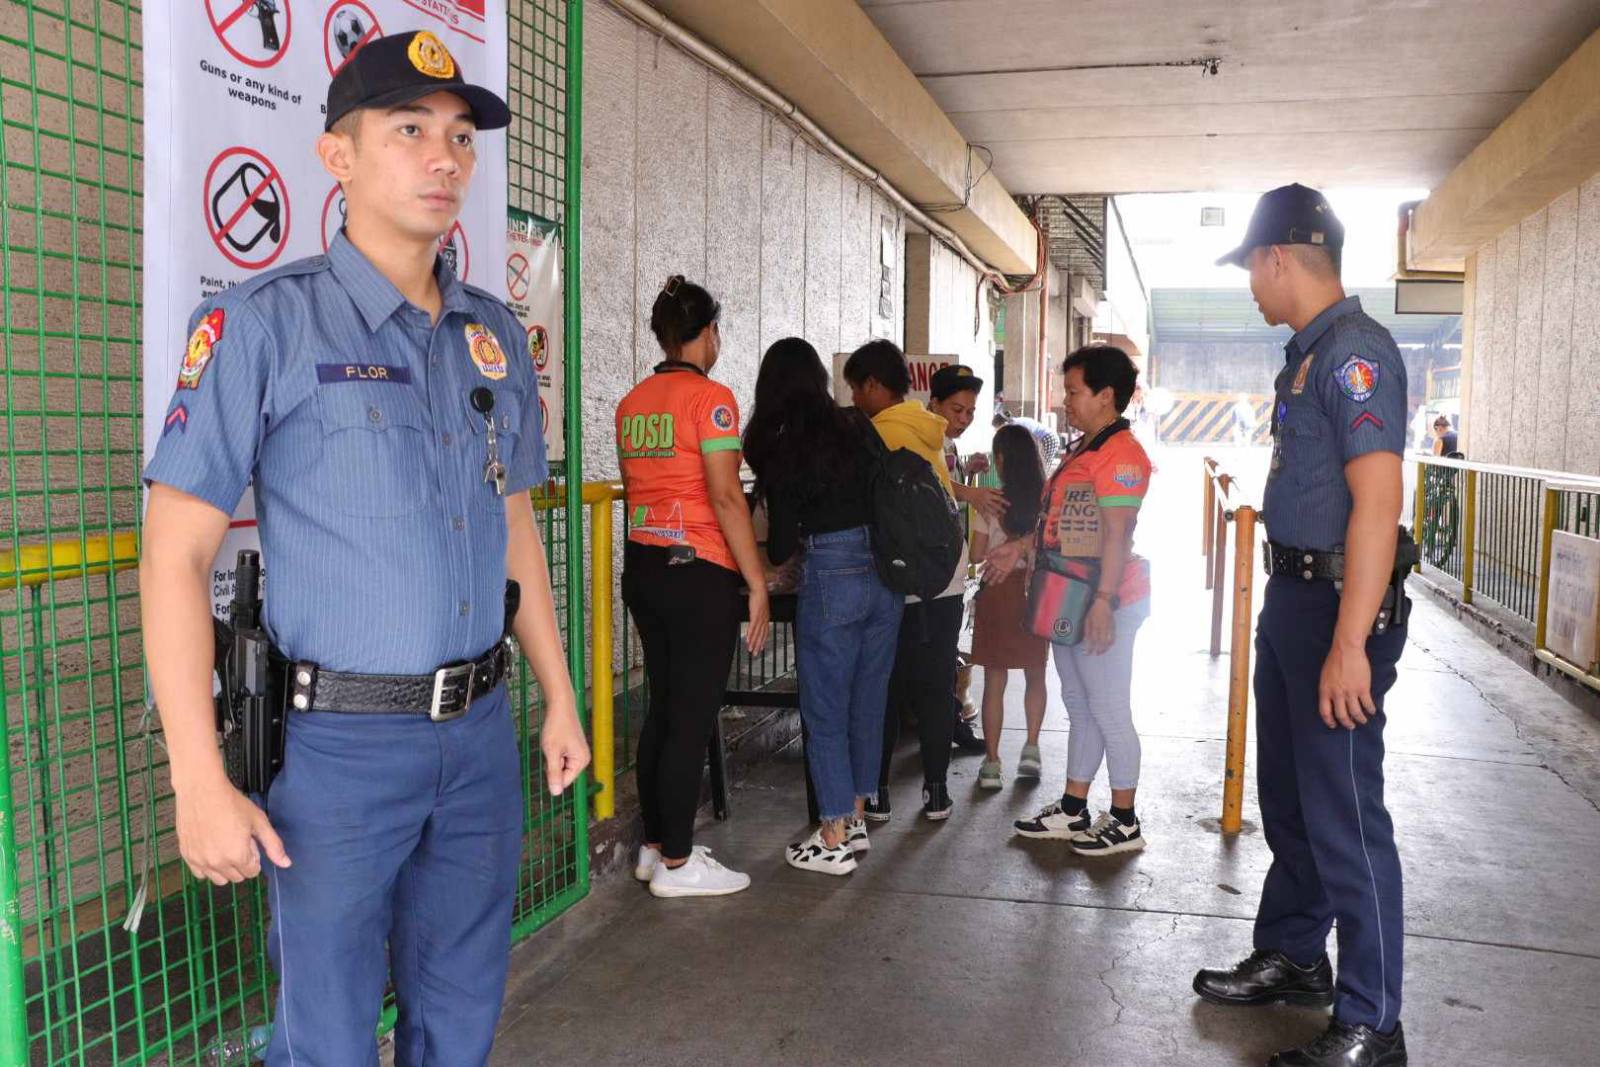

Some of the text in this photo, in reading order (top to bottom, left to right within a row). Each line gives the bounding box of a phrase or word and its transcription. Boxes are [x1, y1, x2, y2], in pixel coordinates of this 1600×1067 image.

[199, 59, 302, 104] Guns or any kind of
[228, 87, 277, 110] weapons
[200, 275, 226, 289] Paint,
[346, 365, 390, 380] FLOR
[214, 570, 227, 583] For
[213, 584, 230, 598] Civil
